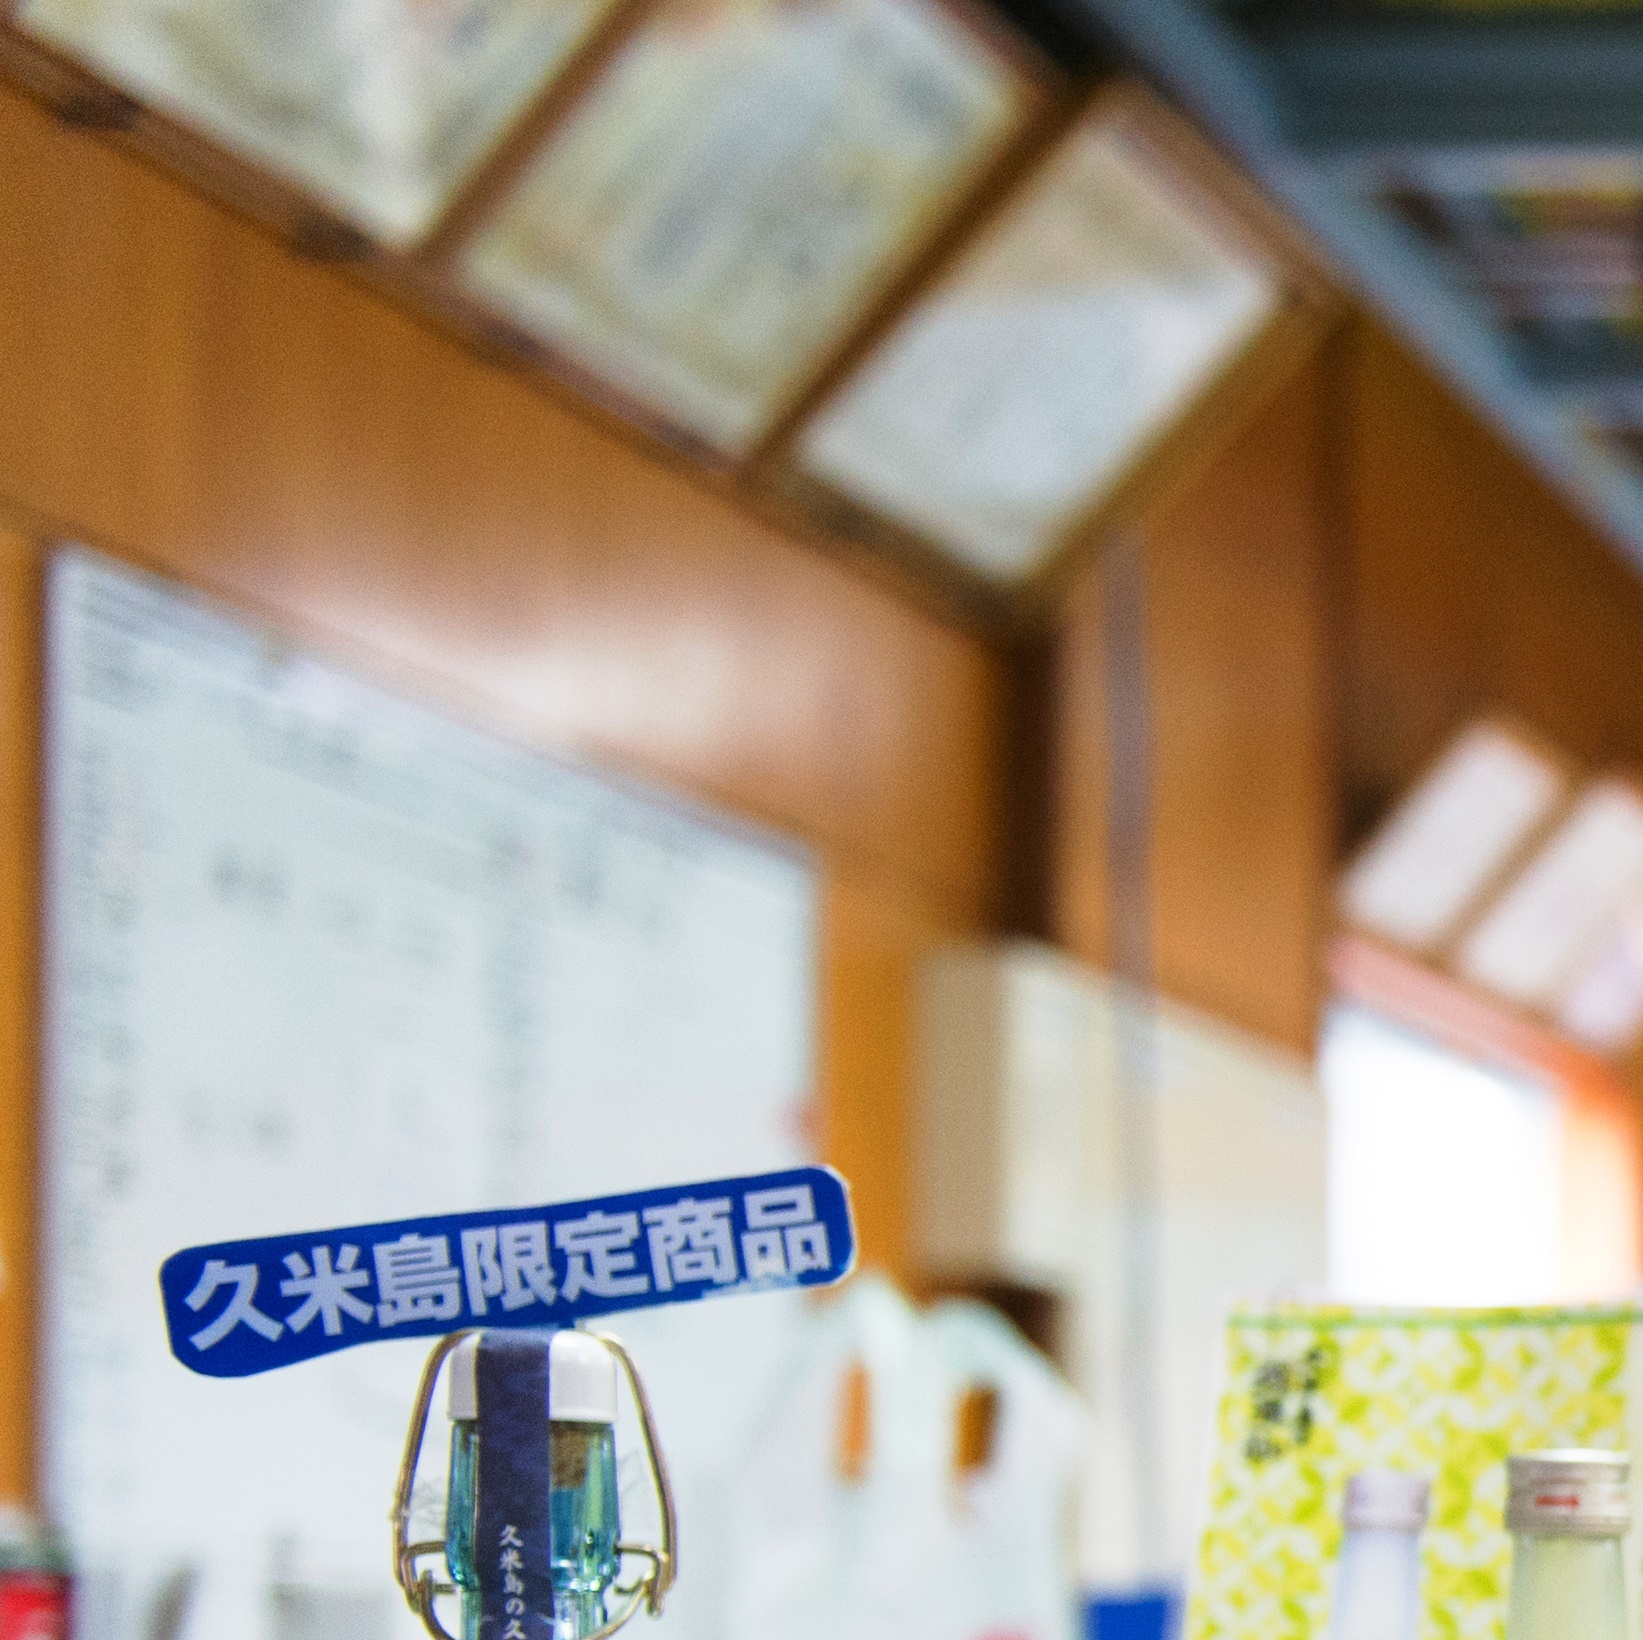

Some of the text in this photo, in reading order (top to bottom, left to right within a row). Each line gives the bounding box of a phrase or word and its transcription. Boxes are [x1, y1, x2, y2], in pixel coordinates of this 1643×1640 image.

[184, 1184, 832, 1351] 久米島限定商品
